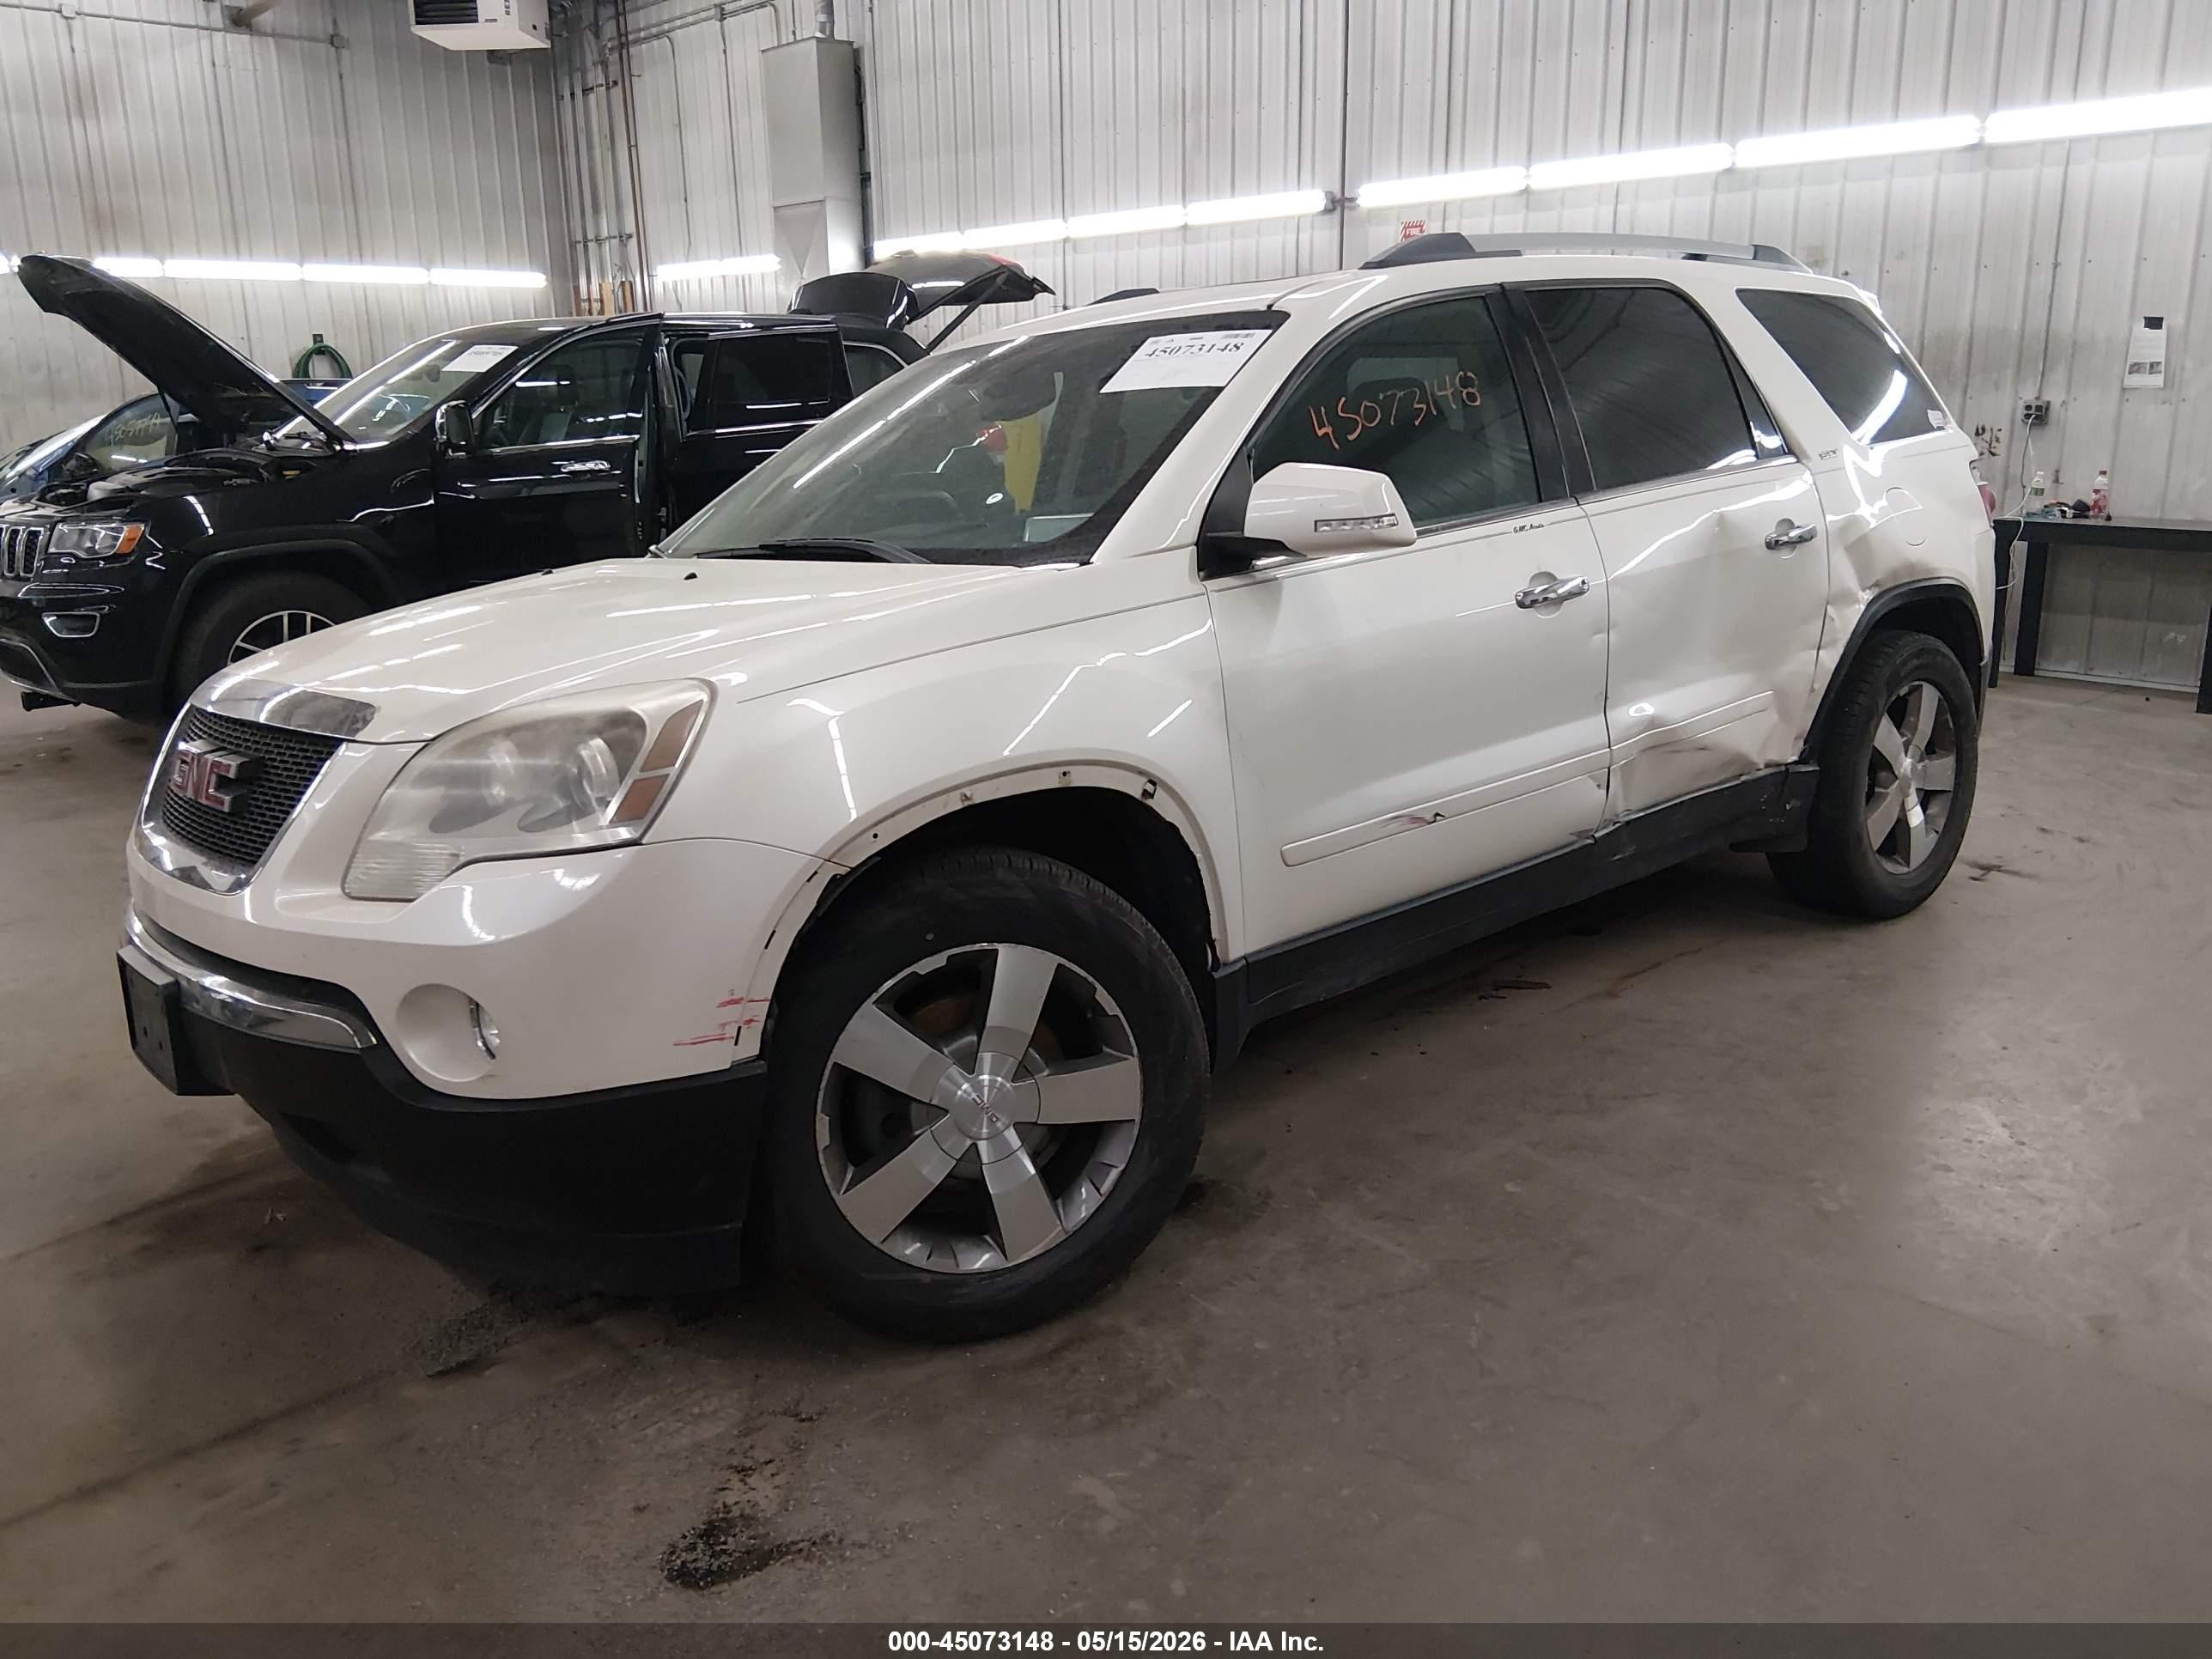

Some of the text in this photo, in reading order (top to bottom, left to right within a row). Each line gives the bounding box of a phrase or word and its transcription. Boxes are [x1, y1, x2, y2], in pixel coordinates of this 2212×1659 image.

[1145, 342, 1244, 358] 45073148
[1308, 371, 1480, 450] 45073148
[173, 741, 250, 813] GMC
